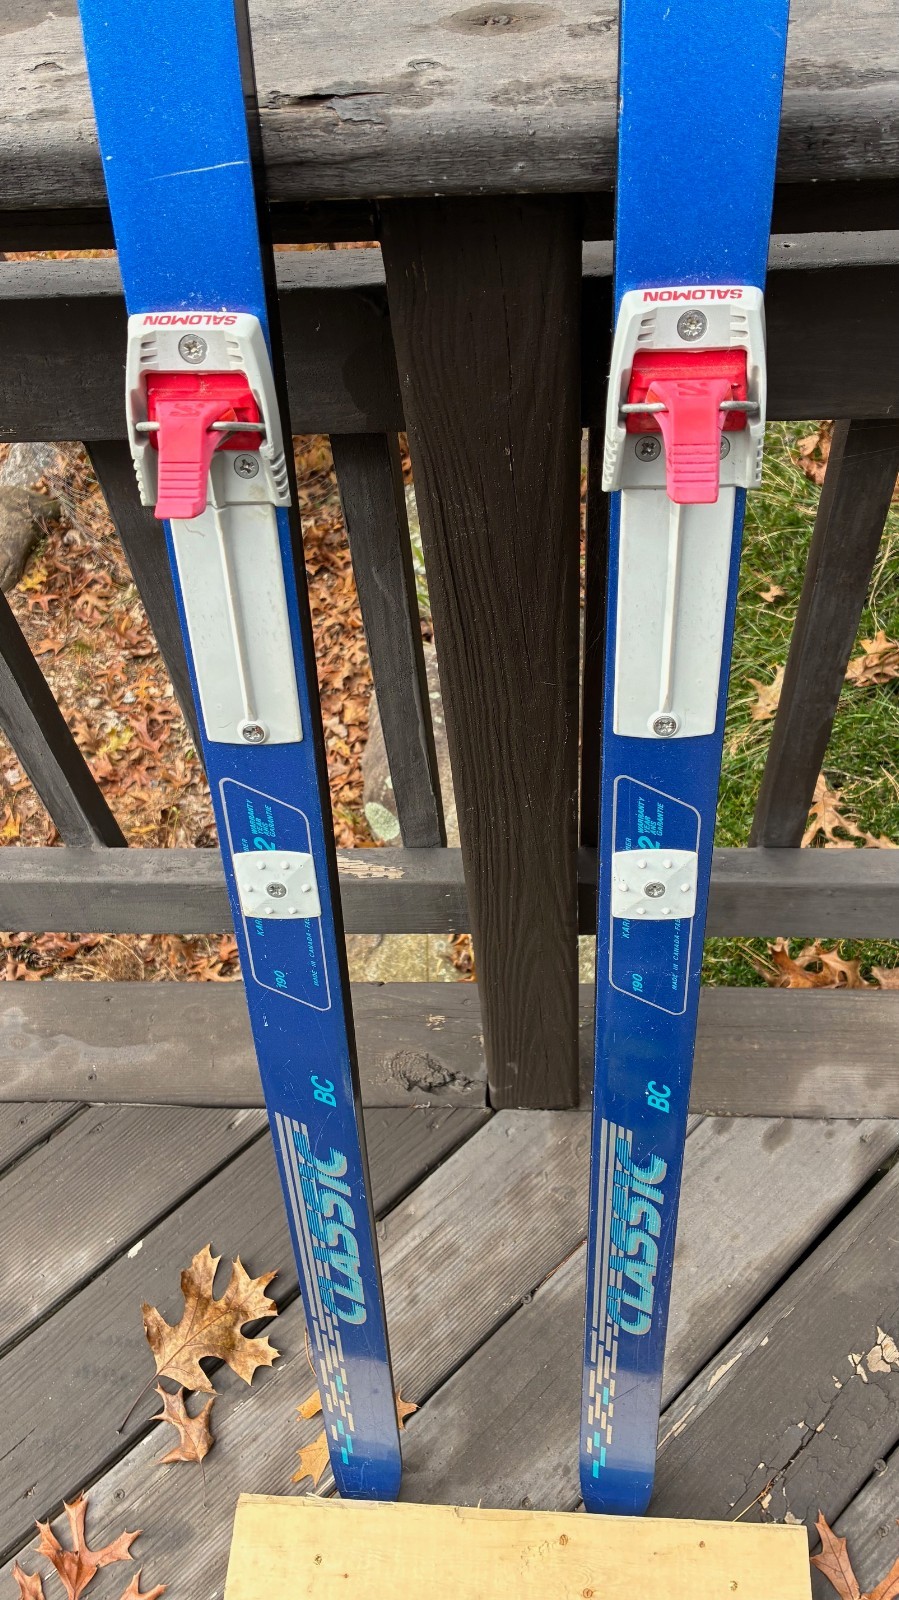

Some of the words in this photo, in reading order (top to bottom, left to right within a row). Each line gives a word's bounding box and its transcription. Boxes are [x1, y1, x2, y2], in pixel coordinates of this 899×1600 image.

[642, 288, 744, 302] SALOMON
[142, 314, 238, 326] SALOMON
[246, 799, 259, 835] WARRANTY
[254, 817, 264, 835] YEAR
[264, 804, 276, 838] GARANTIE
[643, 815, 651, 834] YEAR
[262, 820, 271, 837] ANS
[649, 820, 657, 836] ANS
[253, 836, 277, 852] 2
[638, 836, 660, 850] 2
[310, 960, 317, 968] IN
[273, 969, 288, 989] 190
[311, 970, 319, 986] MADE
[631, 973, 643, 993] 190
[310, 1075, 338, 1108] BC
[647, 1080, 672, 1114] BC
[293, 1130, 367, 1325] CLASSIC
[607, 1137, 668, 1335] CLASSIC
